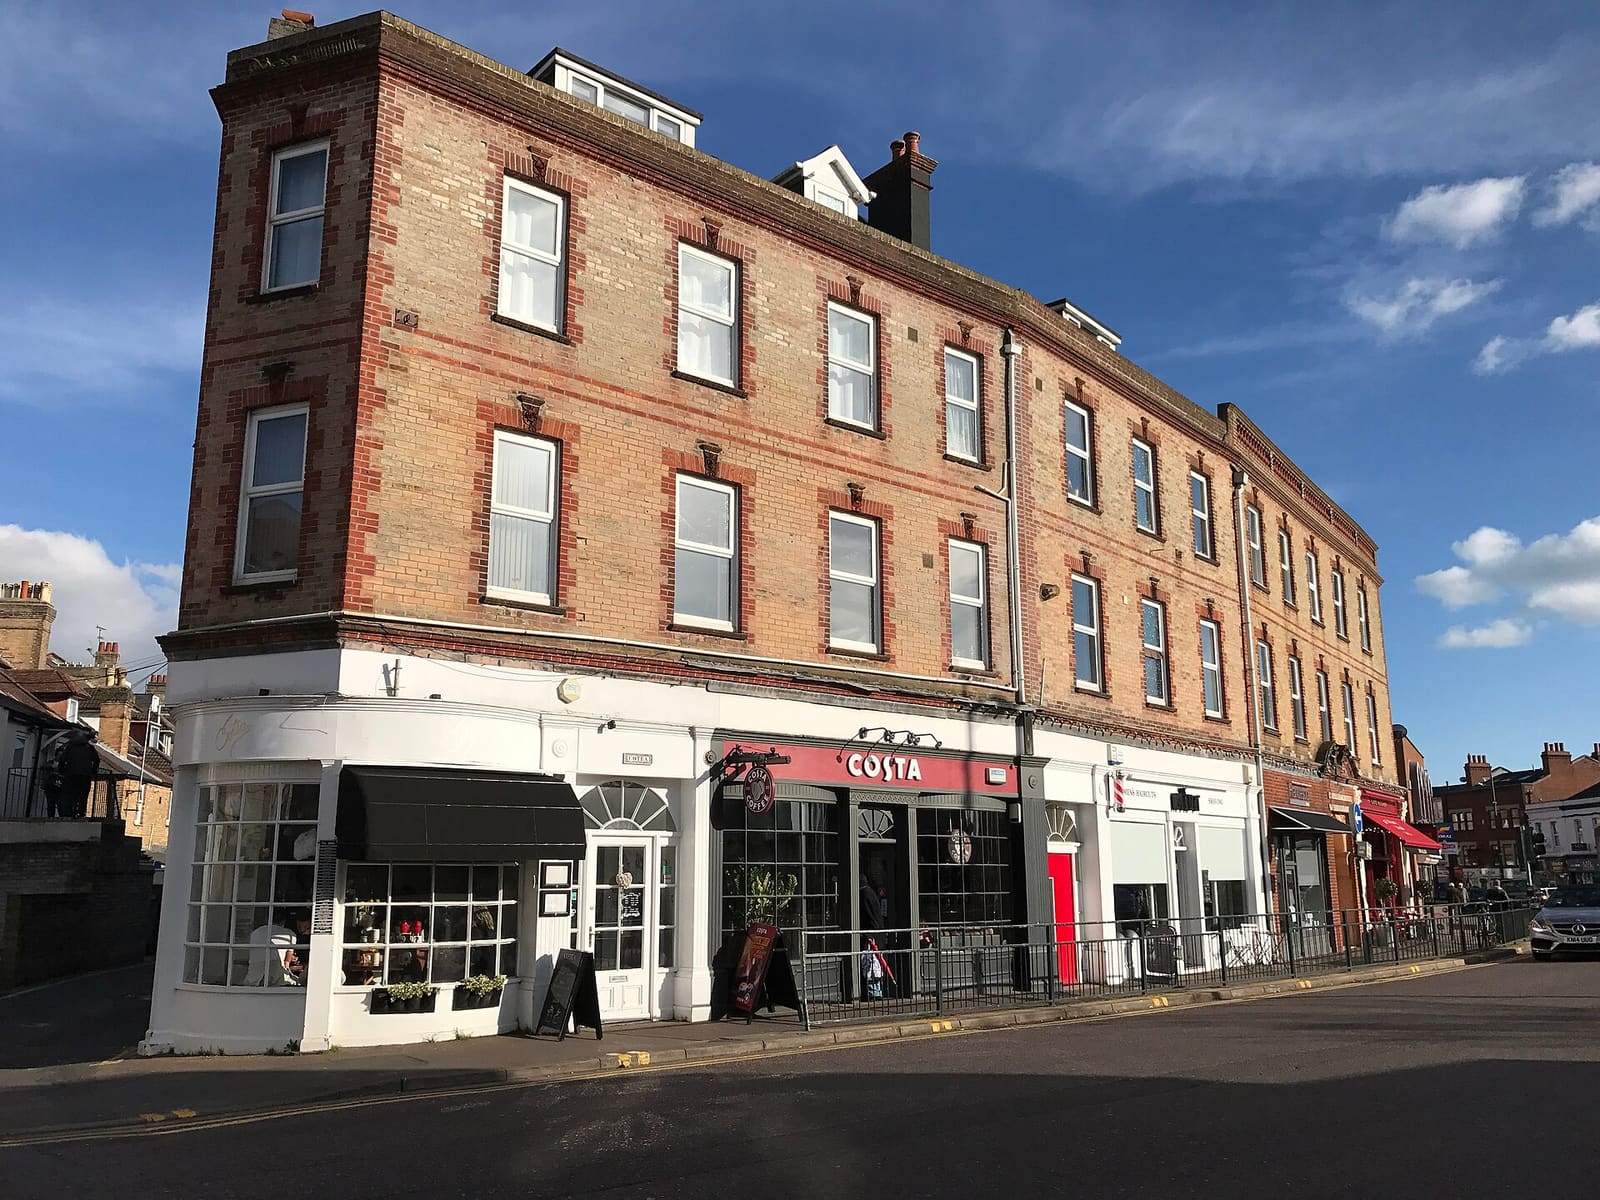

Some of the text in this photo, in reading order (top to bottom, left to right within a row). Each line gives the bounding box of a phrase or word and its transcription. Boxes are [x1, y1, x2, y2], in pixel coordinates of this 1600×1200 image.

[847, 753, 922, 782] COSTA
[748, 770, 767, 783] COSTA
[746, 794, 768, 810] COFFEE
